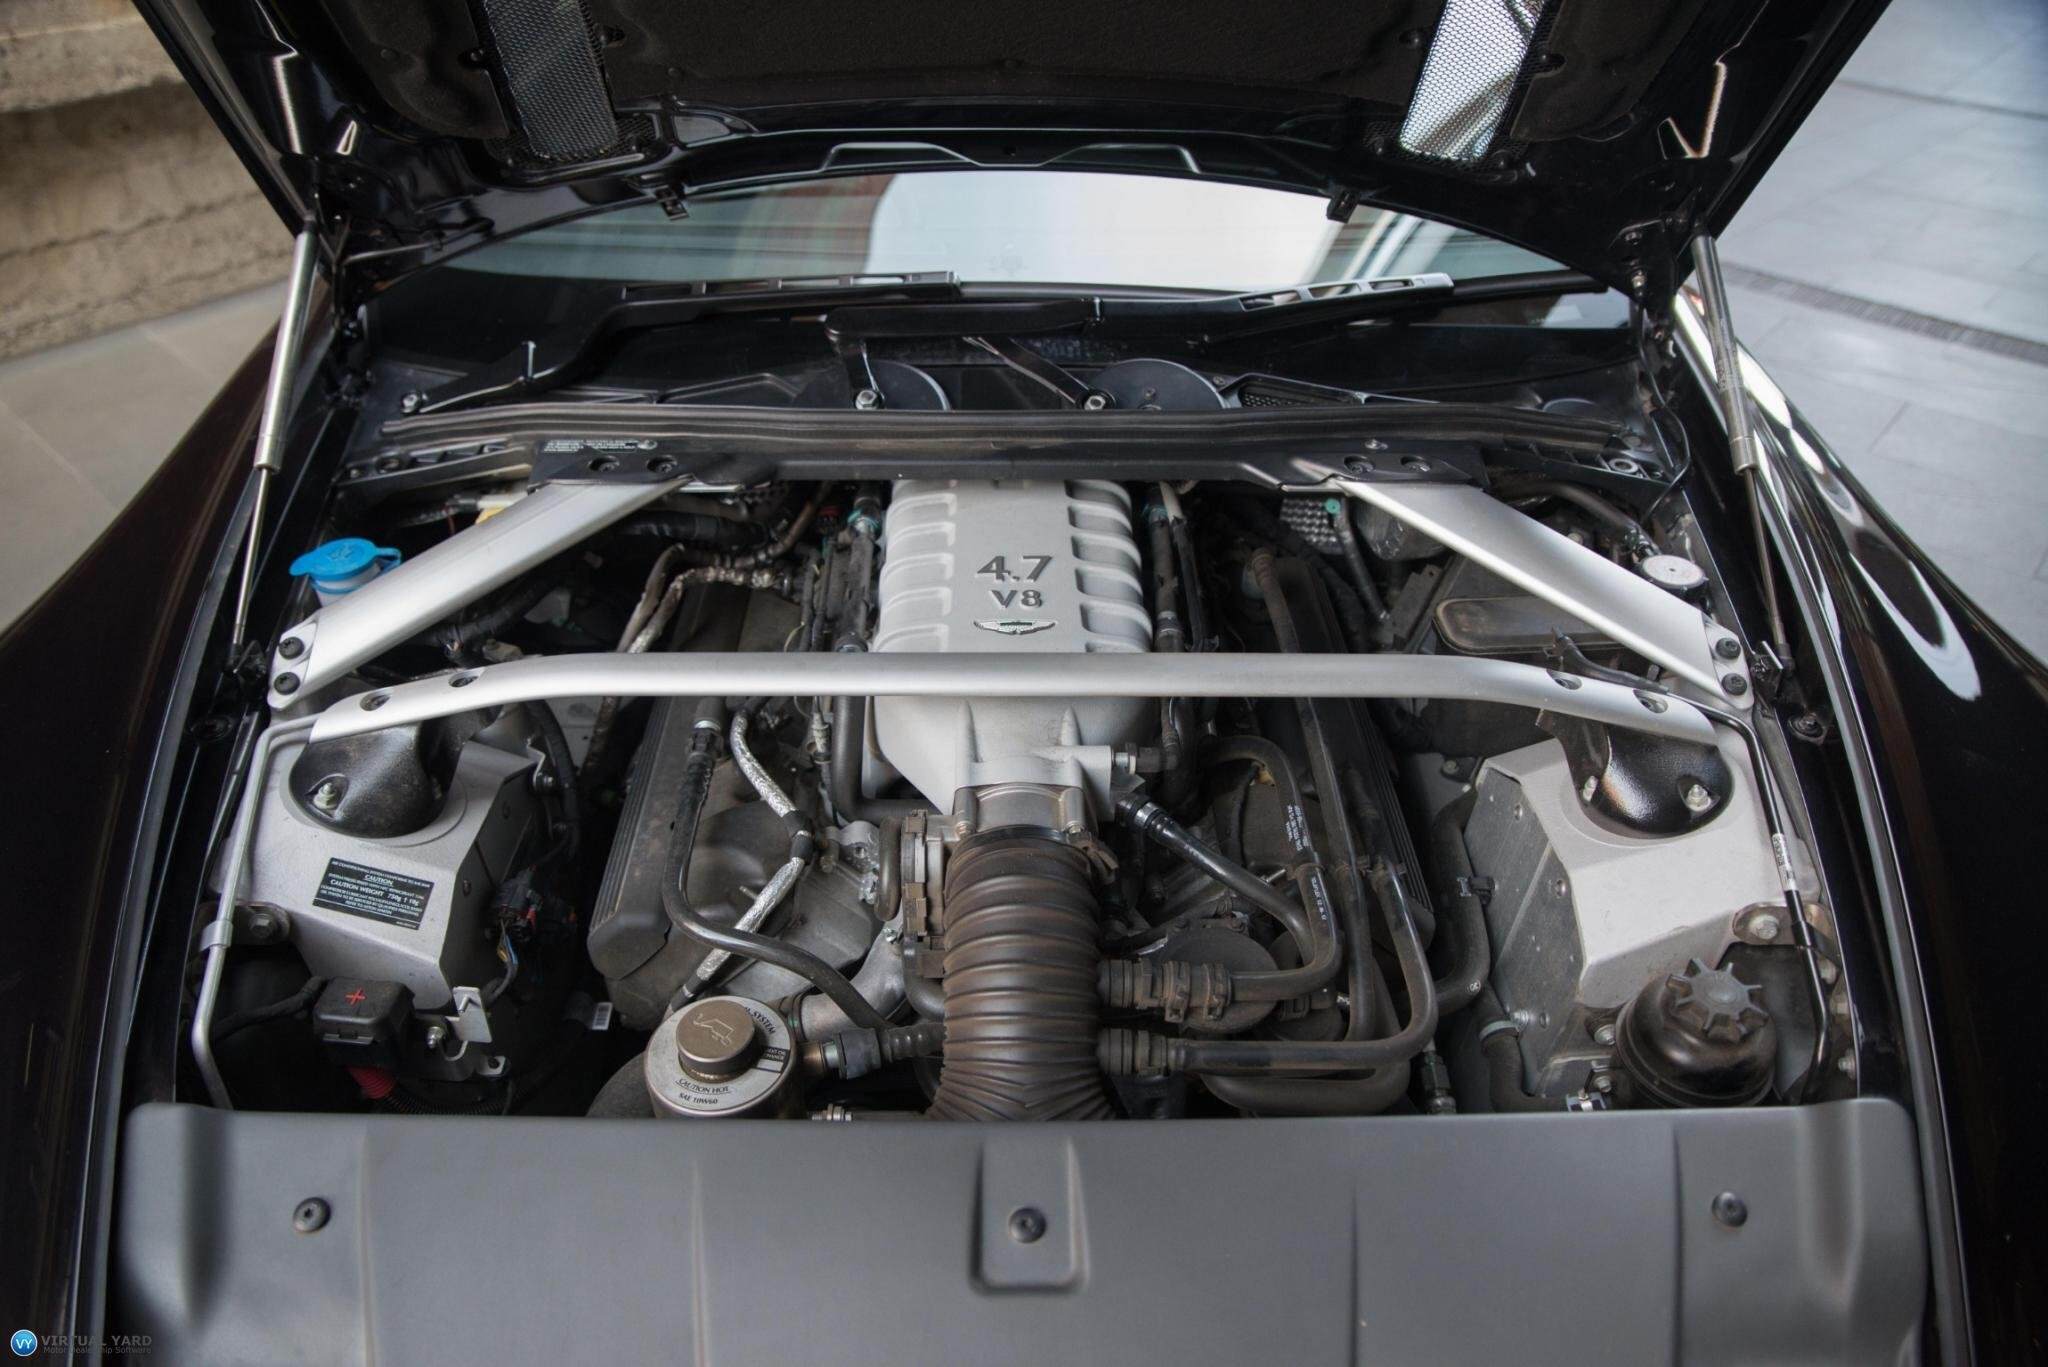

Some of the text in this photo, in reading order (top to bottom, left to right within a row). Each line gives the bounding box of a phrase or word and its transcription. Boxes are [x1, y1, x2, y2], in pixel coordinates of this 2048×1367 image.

[977, 555, 1053, 582] 4.7
[991, 589, 1043, 608] V8
[365, 874, 395, 885] CAUTION
[752, 1010, 776, 1034] SYSTEM
[678, 1079, 729, 1094] CAUTION HOT
[679, 1092, 692, 1102] SAE
